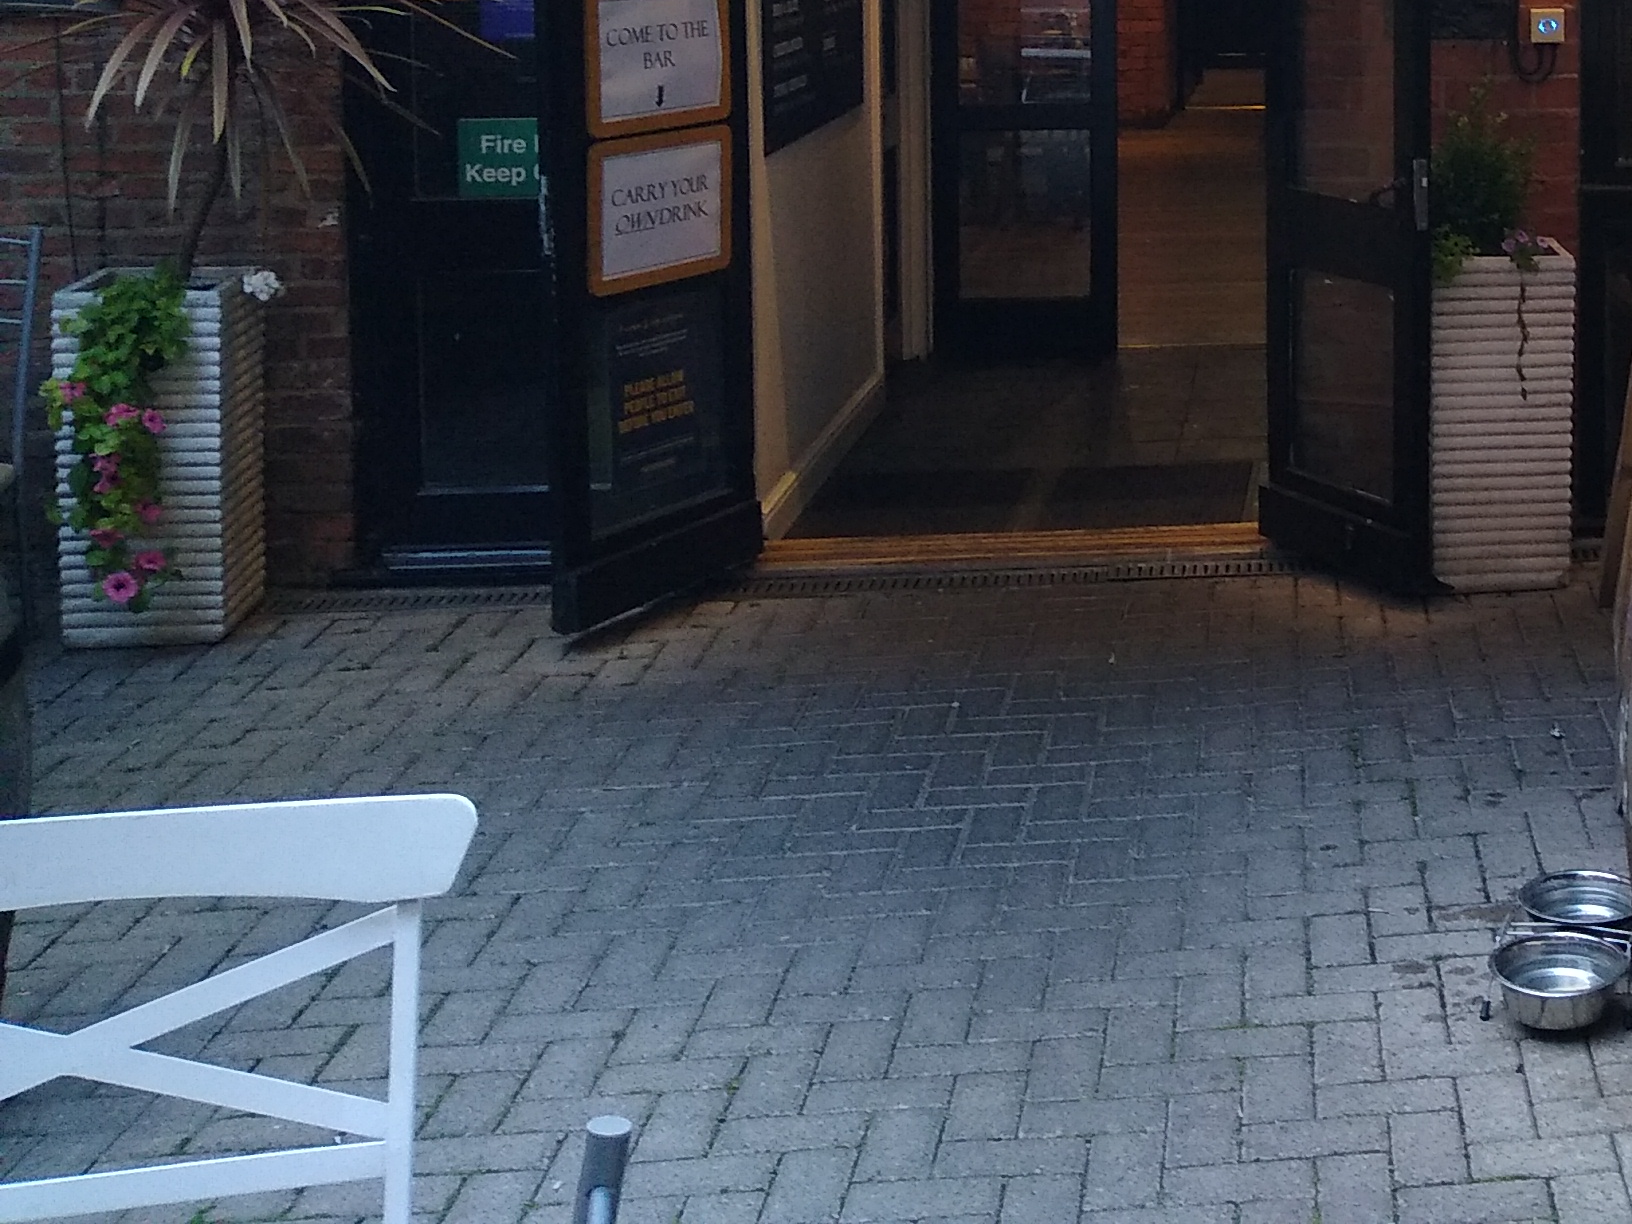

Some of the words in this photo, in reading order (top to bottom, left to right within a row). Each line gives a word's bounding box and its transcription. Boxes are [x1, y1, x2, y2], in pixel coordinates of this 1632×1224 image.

[606, 25, 655, 47] COME
[656, 23, 678, 42] TO
[681, 20, 709, 39] THE
[643, 50, 676, 69] BAR
[480, 134, 526, 154] Fire
[465, 163, 526, 186] Keep
[611, 181, 667, 207] CARRY
[670, 174, 709, 198] YOUR
[615, 209, 659, 235] OWN
[659, 200, 709, 225] DRINK
